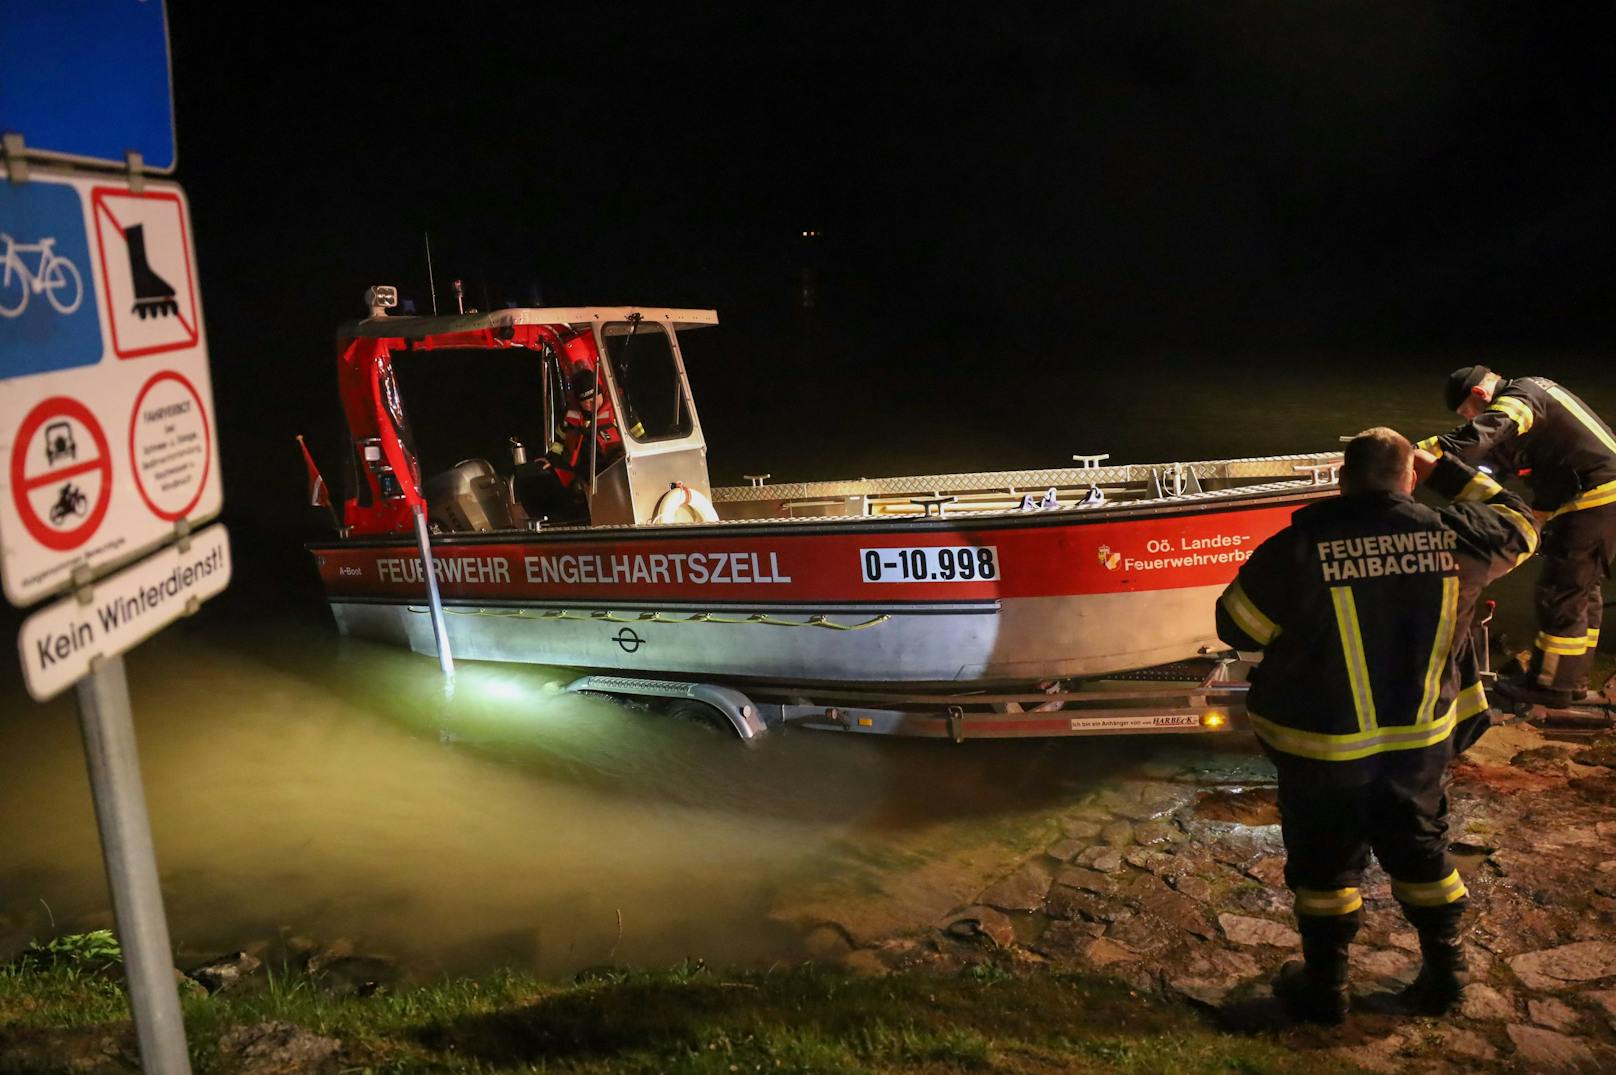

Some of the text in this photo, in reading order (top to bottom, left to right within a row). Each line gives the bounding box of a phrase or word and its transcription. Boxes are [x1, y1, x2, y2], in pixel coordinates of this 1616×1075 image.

[1146, 534, 1251, 553] Oö. Landes-
[1317, 530, 1457, 561] FEUERWEHR
[339, 567, 363, 576] A-Boot
[376, 552, 792, 584] FEUERWEHR ENGELHARTSZELL
[1124, 549, 1254, 571] Feuerwehrverba
[36, 621, 94, 670] Kein
[97, 545, 224, 634] Winterdienst!
